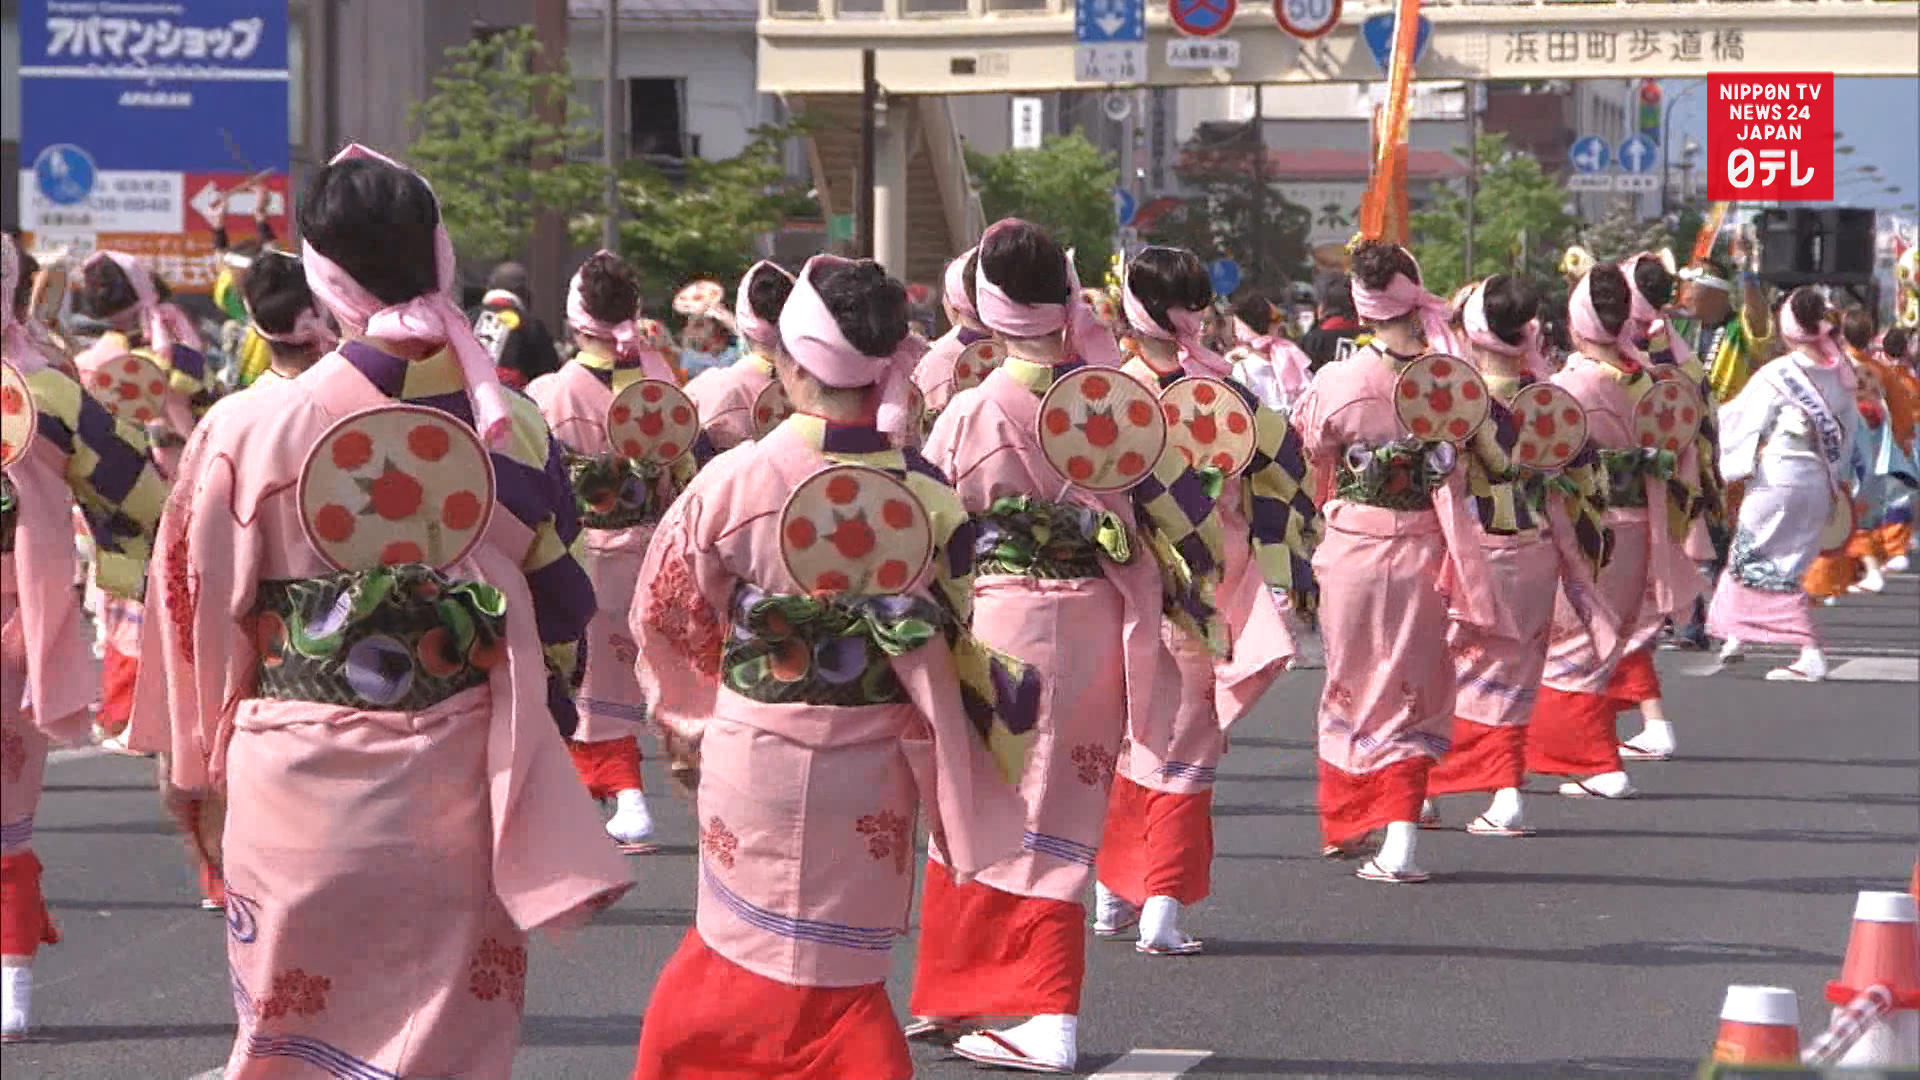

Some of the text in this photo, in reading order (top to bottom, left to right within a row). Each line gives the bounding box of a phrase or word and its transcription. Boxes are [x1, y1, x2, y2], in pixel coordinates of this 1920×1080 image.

[46, 16, 264, 60] アパマンショップ
[1504, 28, 1745, 63] 浜田町歩道橋
